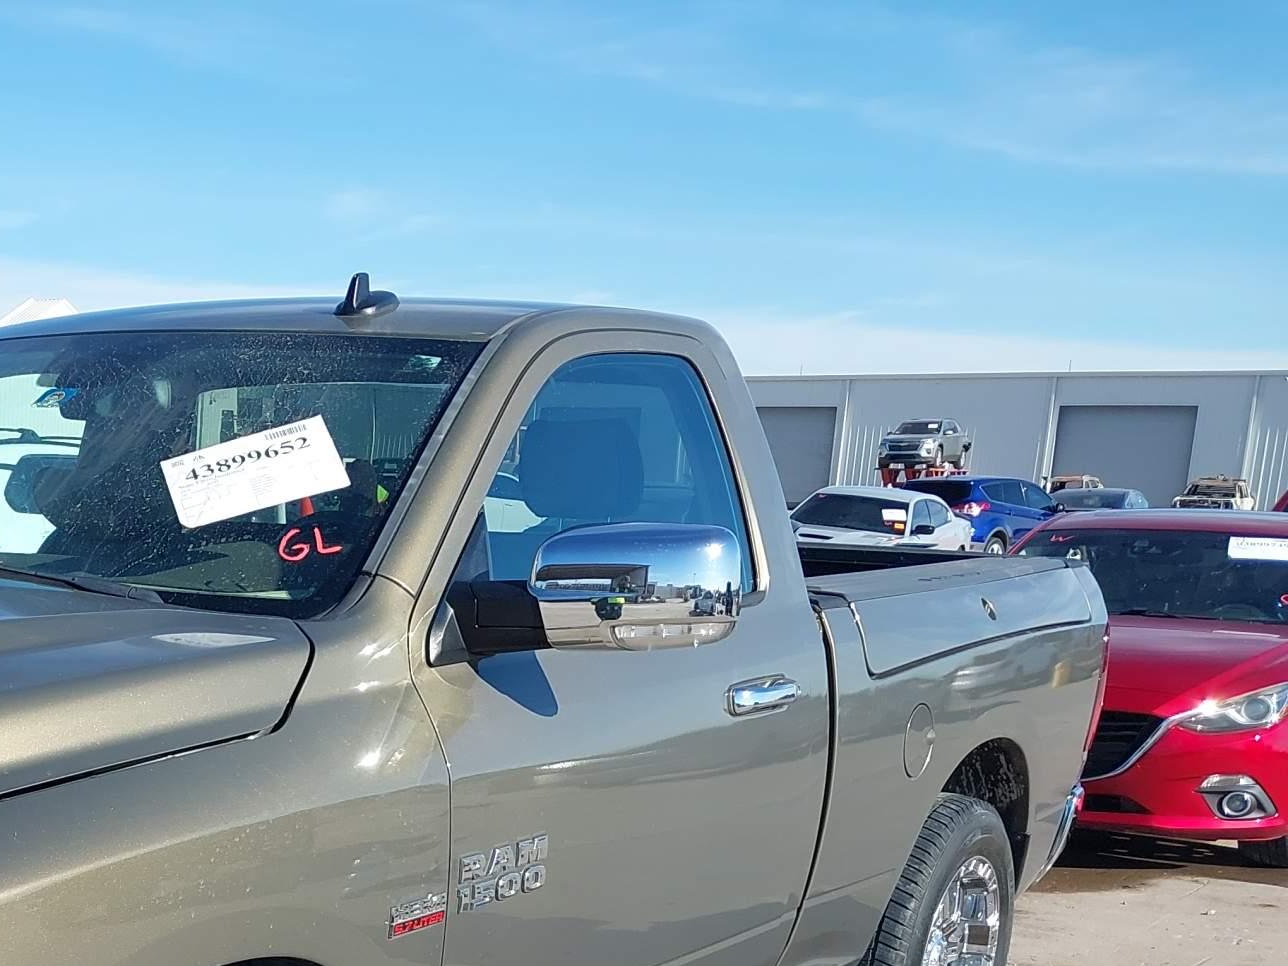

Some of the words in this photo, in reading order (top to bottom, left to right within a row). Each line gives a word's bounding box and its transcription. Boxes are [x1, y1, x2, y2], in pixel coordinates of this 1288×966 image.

[185, 437, 311, 482] 43899652
[279, 527, 344, 562] GL
[458, 834, 548, 884] RAM
[457, 864, 547, 914] 1500
